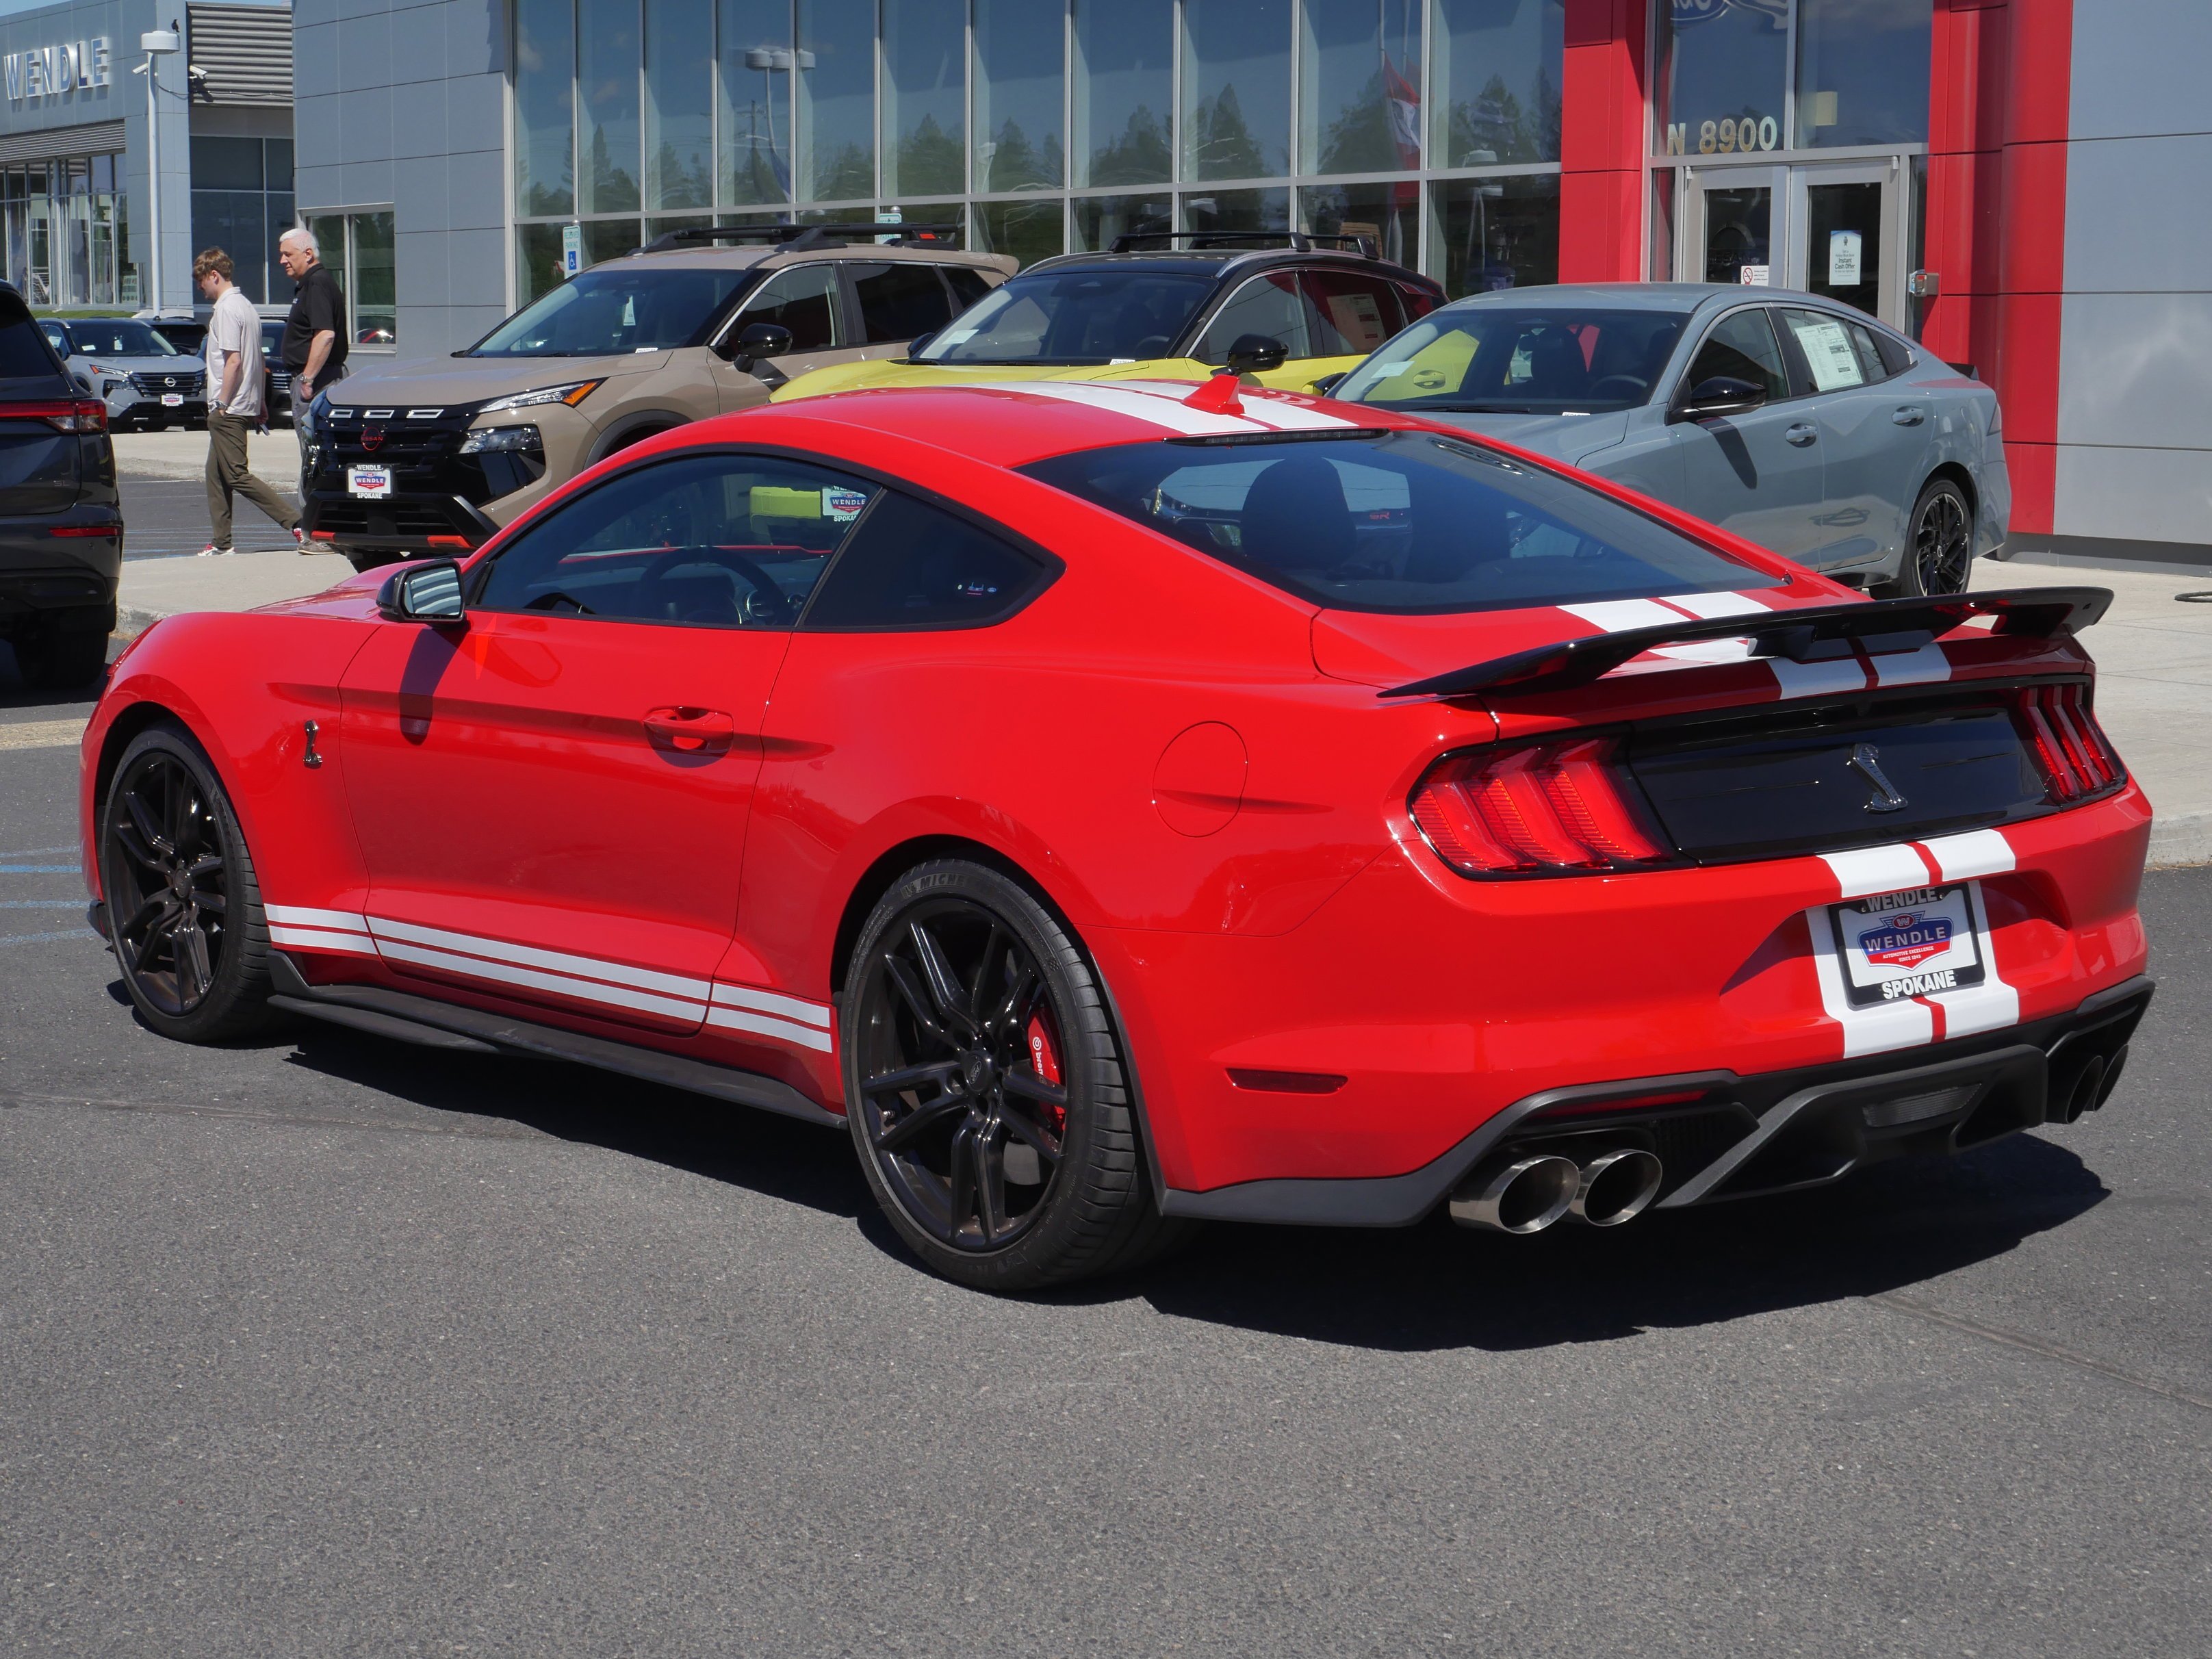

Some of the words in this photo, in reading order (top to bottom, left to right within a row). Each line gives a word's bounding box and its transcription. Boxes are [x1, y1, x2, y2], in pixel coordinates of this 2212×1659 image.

[3, 36, 110, 100] WENDLE
[1699, 116, 1777, 155] 8900
[1866, 887, 1938, 912] WENDLE
[1866, 927, 1946, 951] WENDLE
[1883, 951, 1909, 959] AUTOMOTIVE
[1908, 946, 1934, 955] EXCELLENCE
[1881, 970, 1957, 999] SPOKANE
